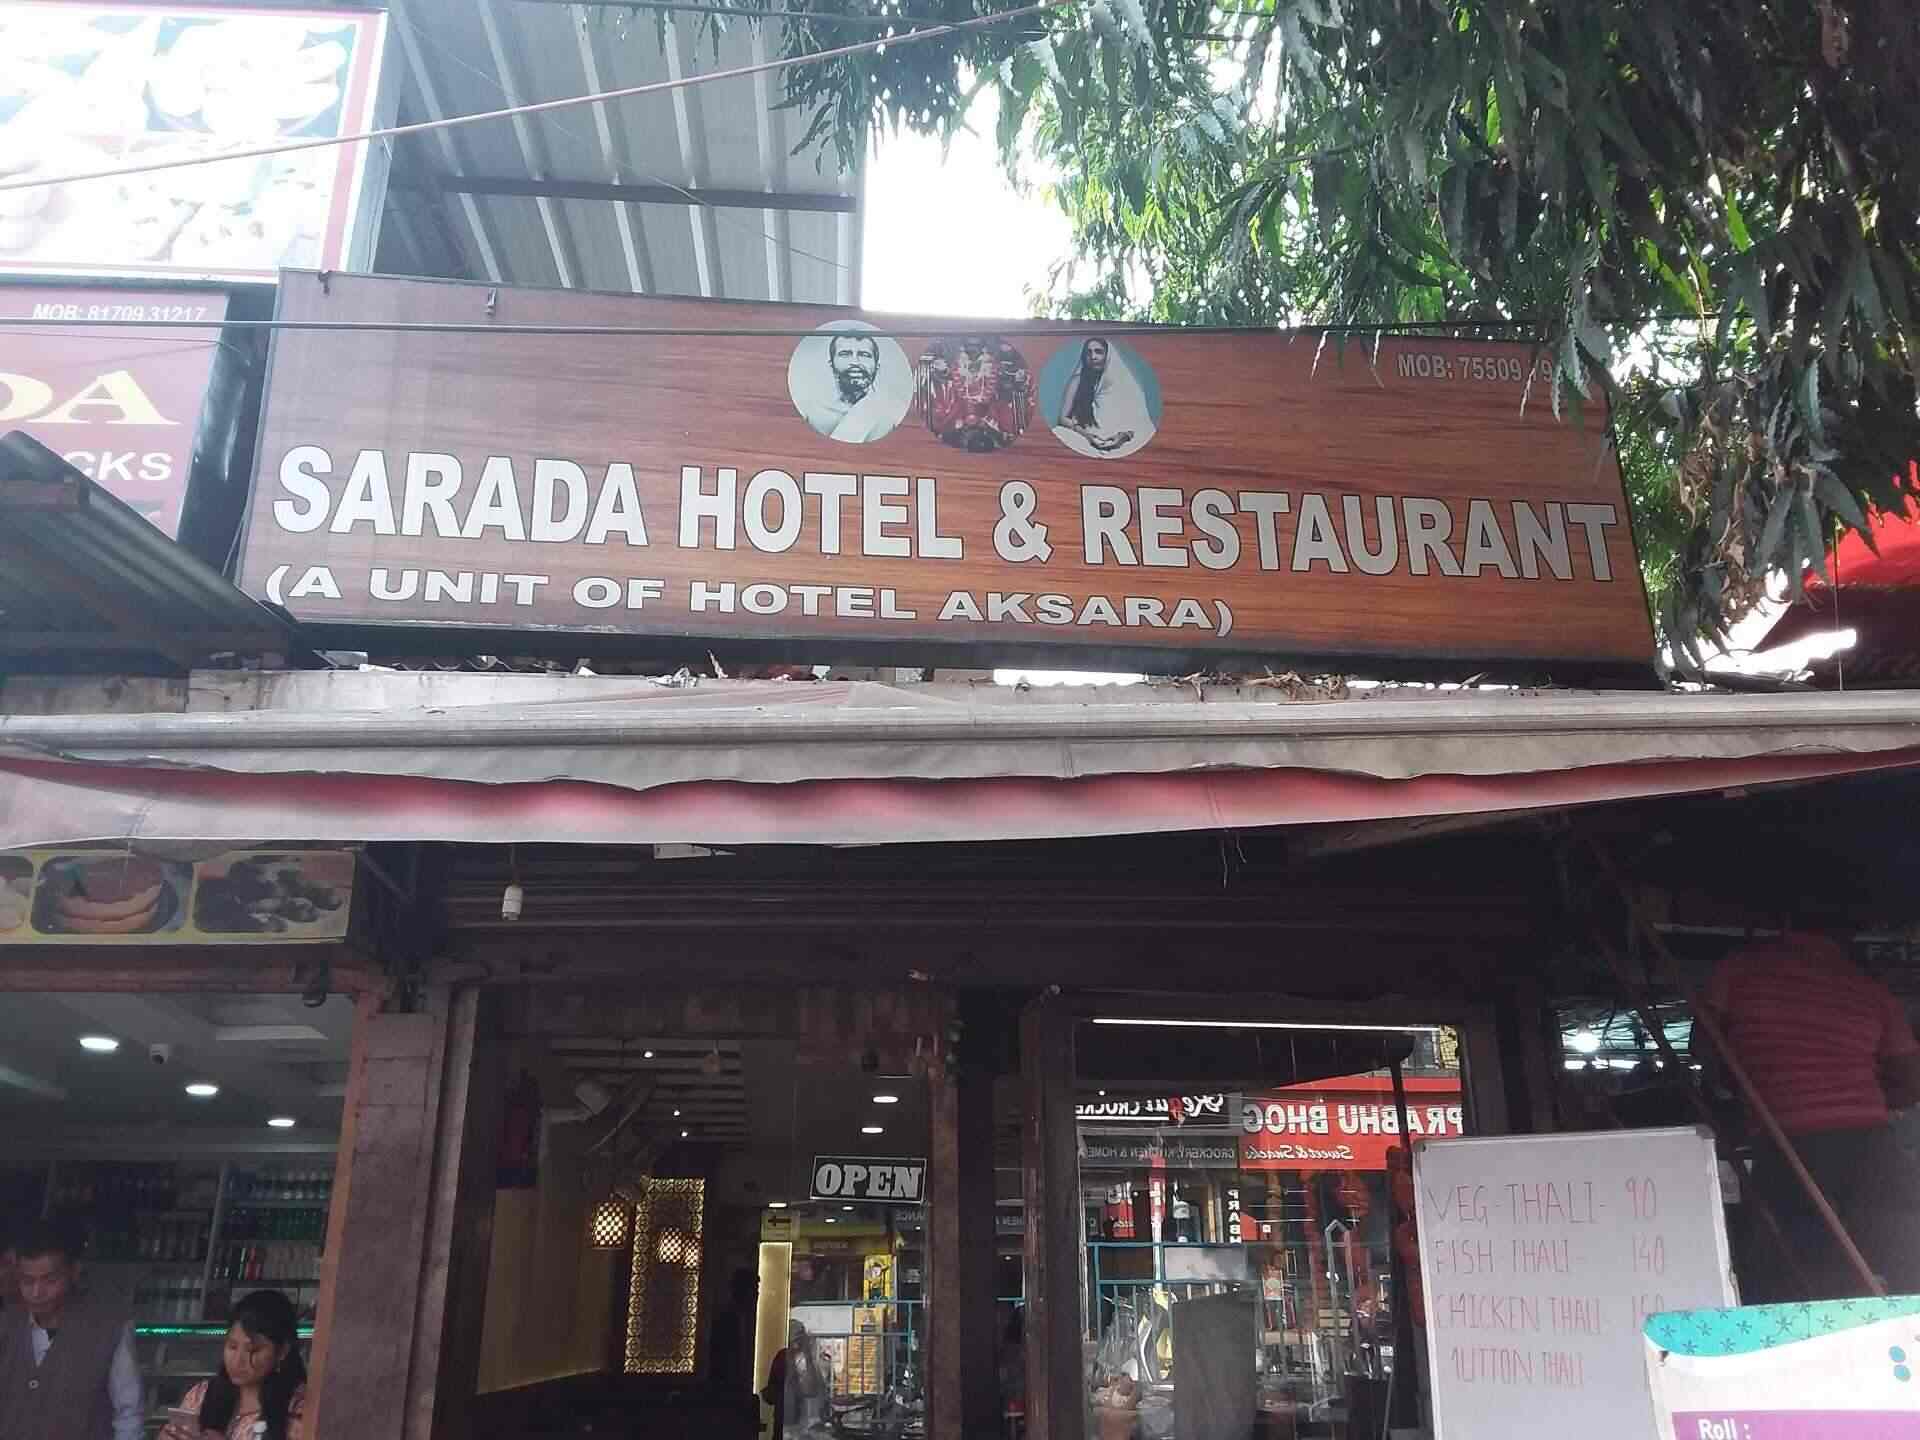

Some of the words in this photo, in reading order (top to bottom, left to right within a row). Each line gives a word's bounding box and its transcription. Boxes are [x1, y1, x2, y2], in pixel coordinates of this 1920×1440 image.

[1398, 353, 1453, 379] MOB:
[272, 445, 648, 547] SARADA
[678, 465, 965, 561] HOTEL
[993, 480, 1053, 563] &
[1079, 484, 1617, 582] RESTAURANT
[265, 563, 342, 606] (A
[369, 567, 549, 606] UNIT
[571, 576, 665, 609] OF
[689, 580, 918, 620] HOTEL
[936, 591, 1234, 637] AKSARA)
[815, 1164, 921, 1197] OPEN
[1435, 1239, 1496, 1275] FISH
